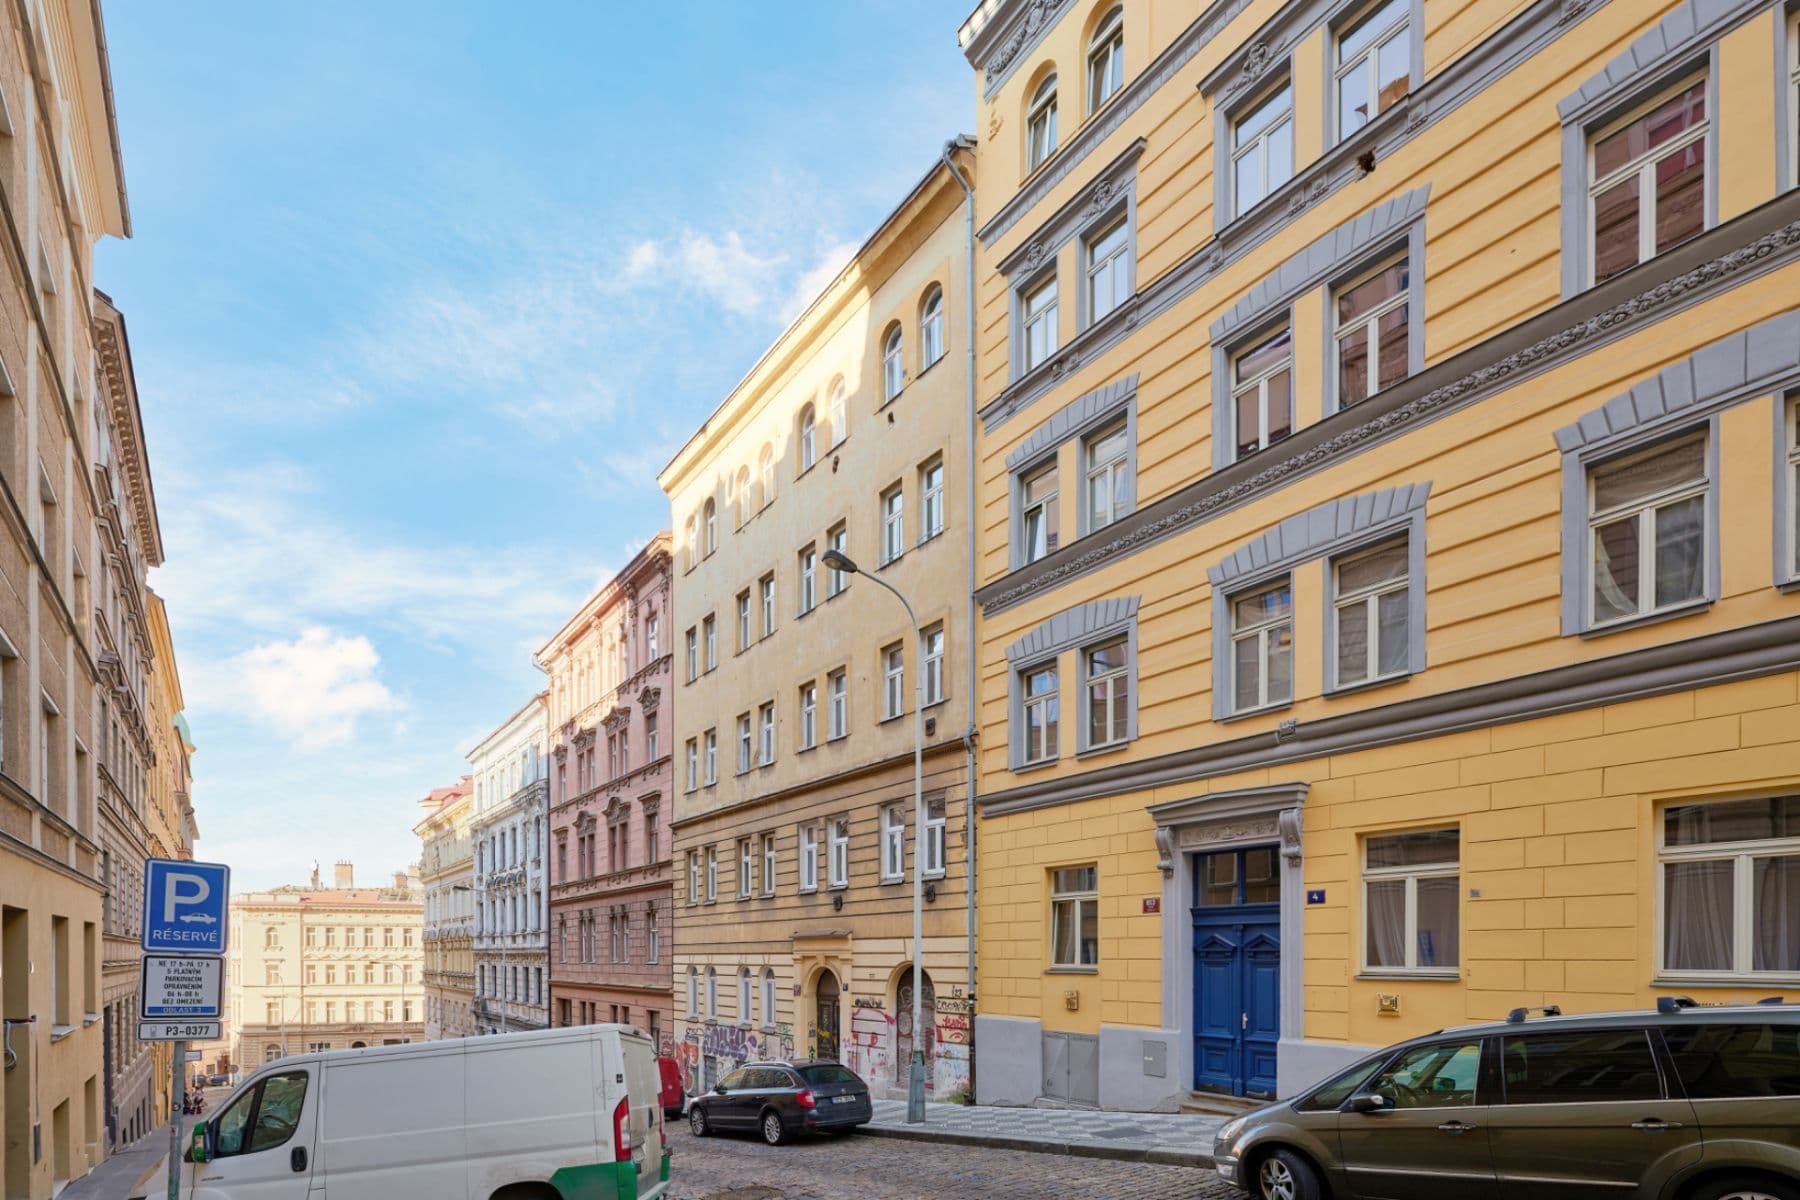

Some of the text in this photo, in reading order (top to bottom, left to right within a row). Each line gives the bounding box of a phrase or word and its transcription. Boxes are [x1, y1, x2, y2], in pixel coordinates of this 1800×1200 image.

[164, 872, 210, 922] P
[153, 928, 217, 942] RÉSERVÉ
[166, 1026, 210, 1036] P3-0377
